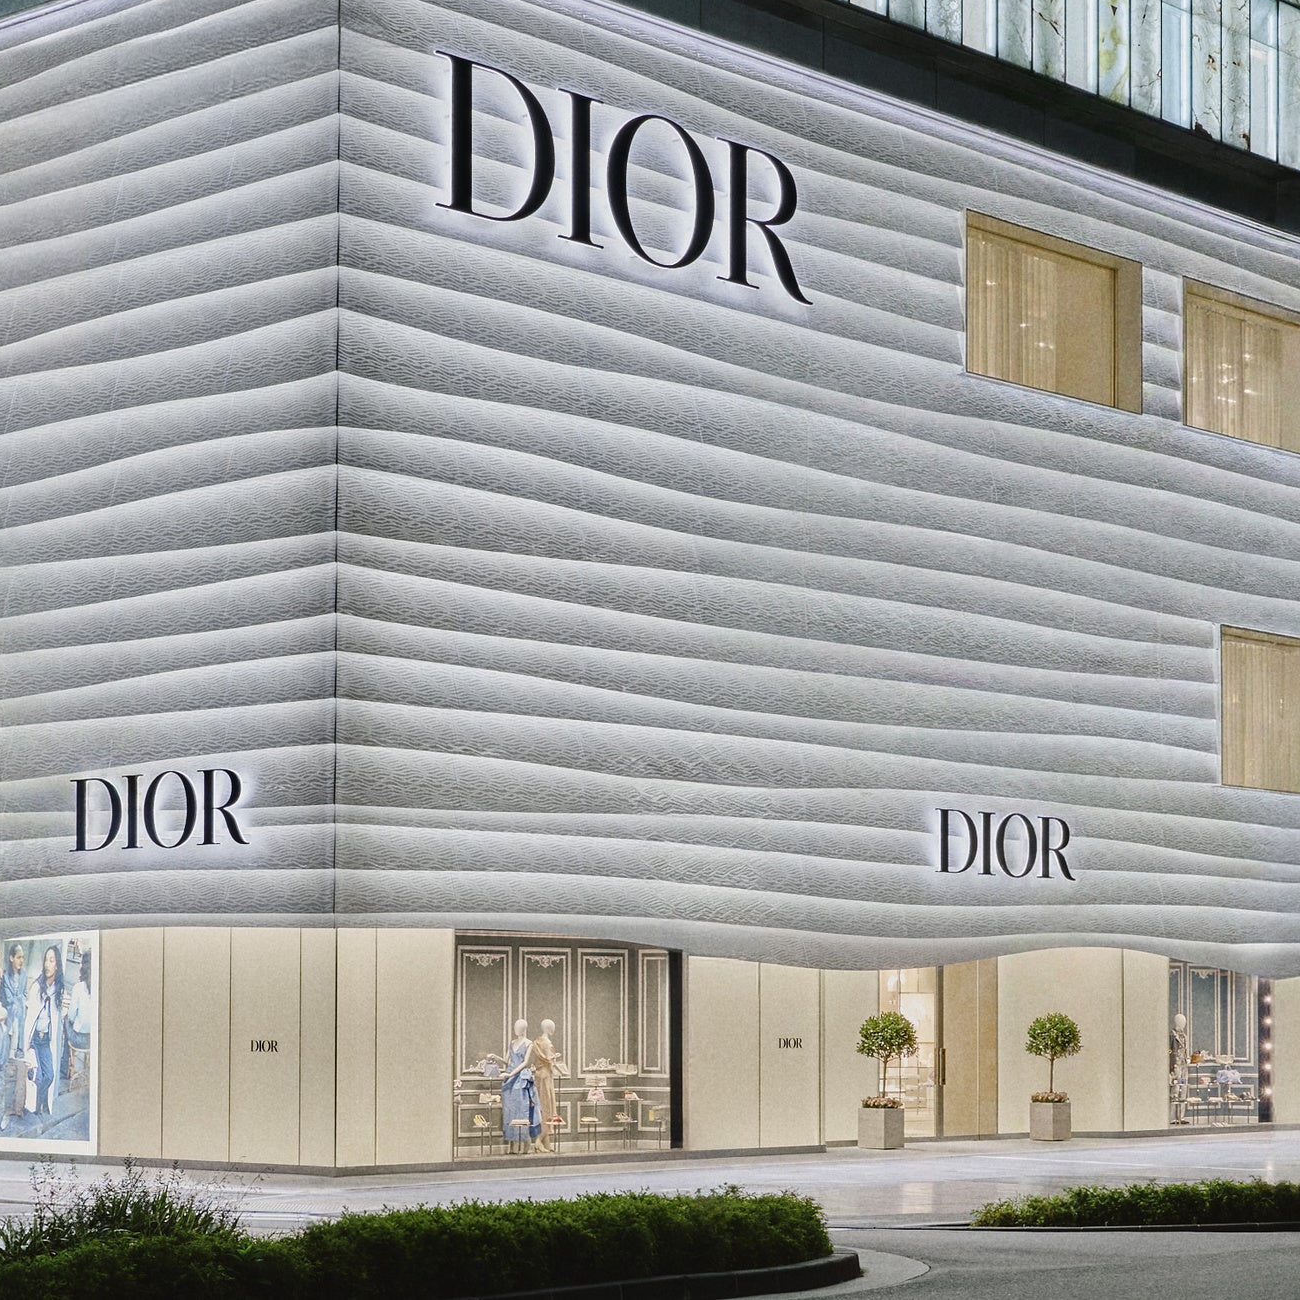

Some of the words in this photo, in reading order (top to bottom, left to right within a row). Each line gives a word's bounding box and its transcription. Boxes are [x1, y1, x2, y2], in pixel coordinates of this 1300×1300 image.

[435, 50, 813, 305] DIOR
[70, 768, 250, 852] DIOR
[935, 808, 1076, 881] DIOR
[250, 1039, 278, 1053] DIOR
[778, 1037, 803, 1049] DIOR
